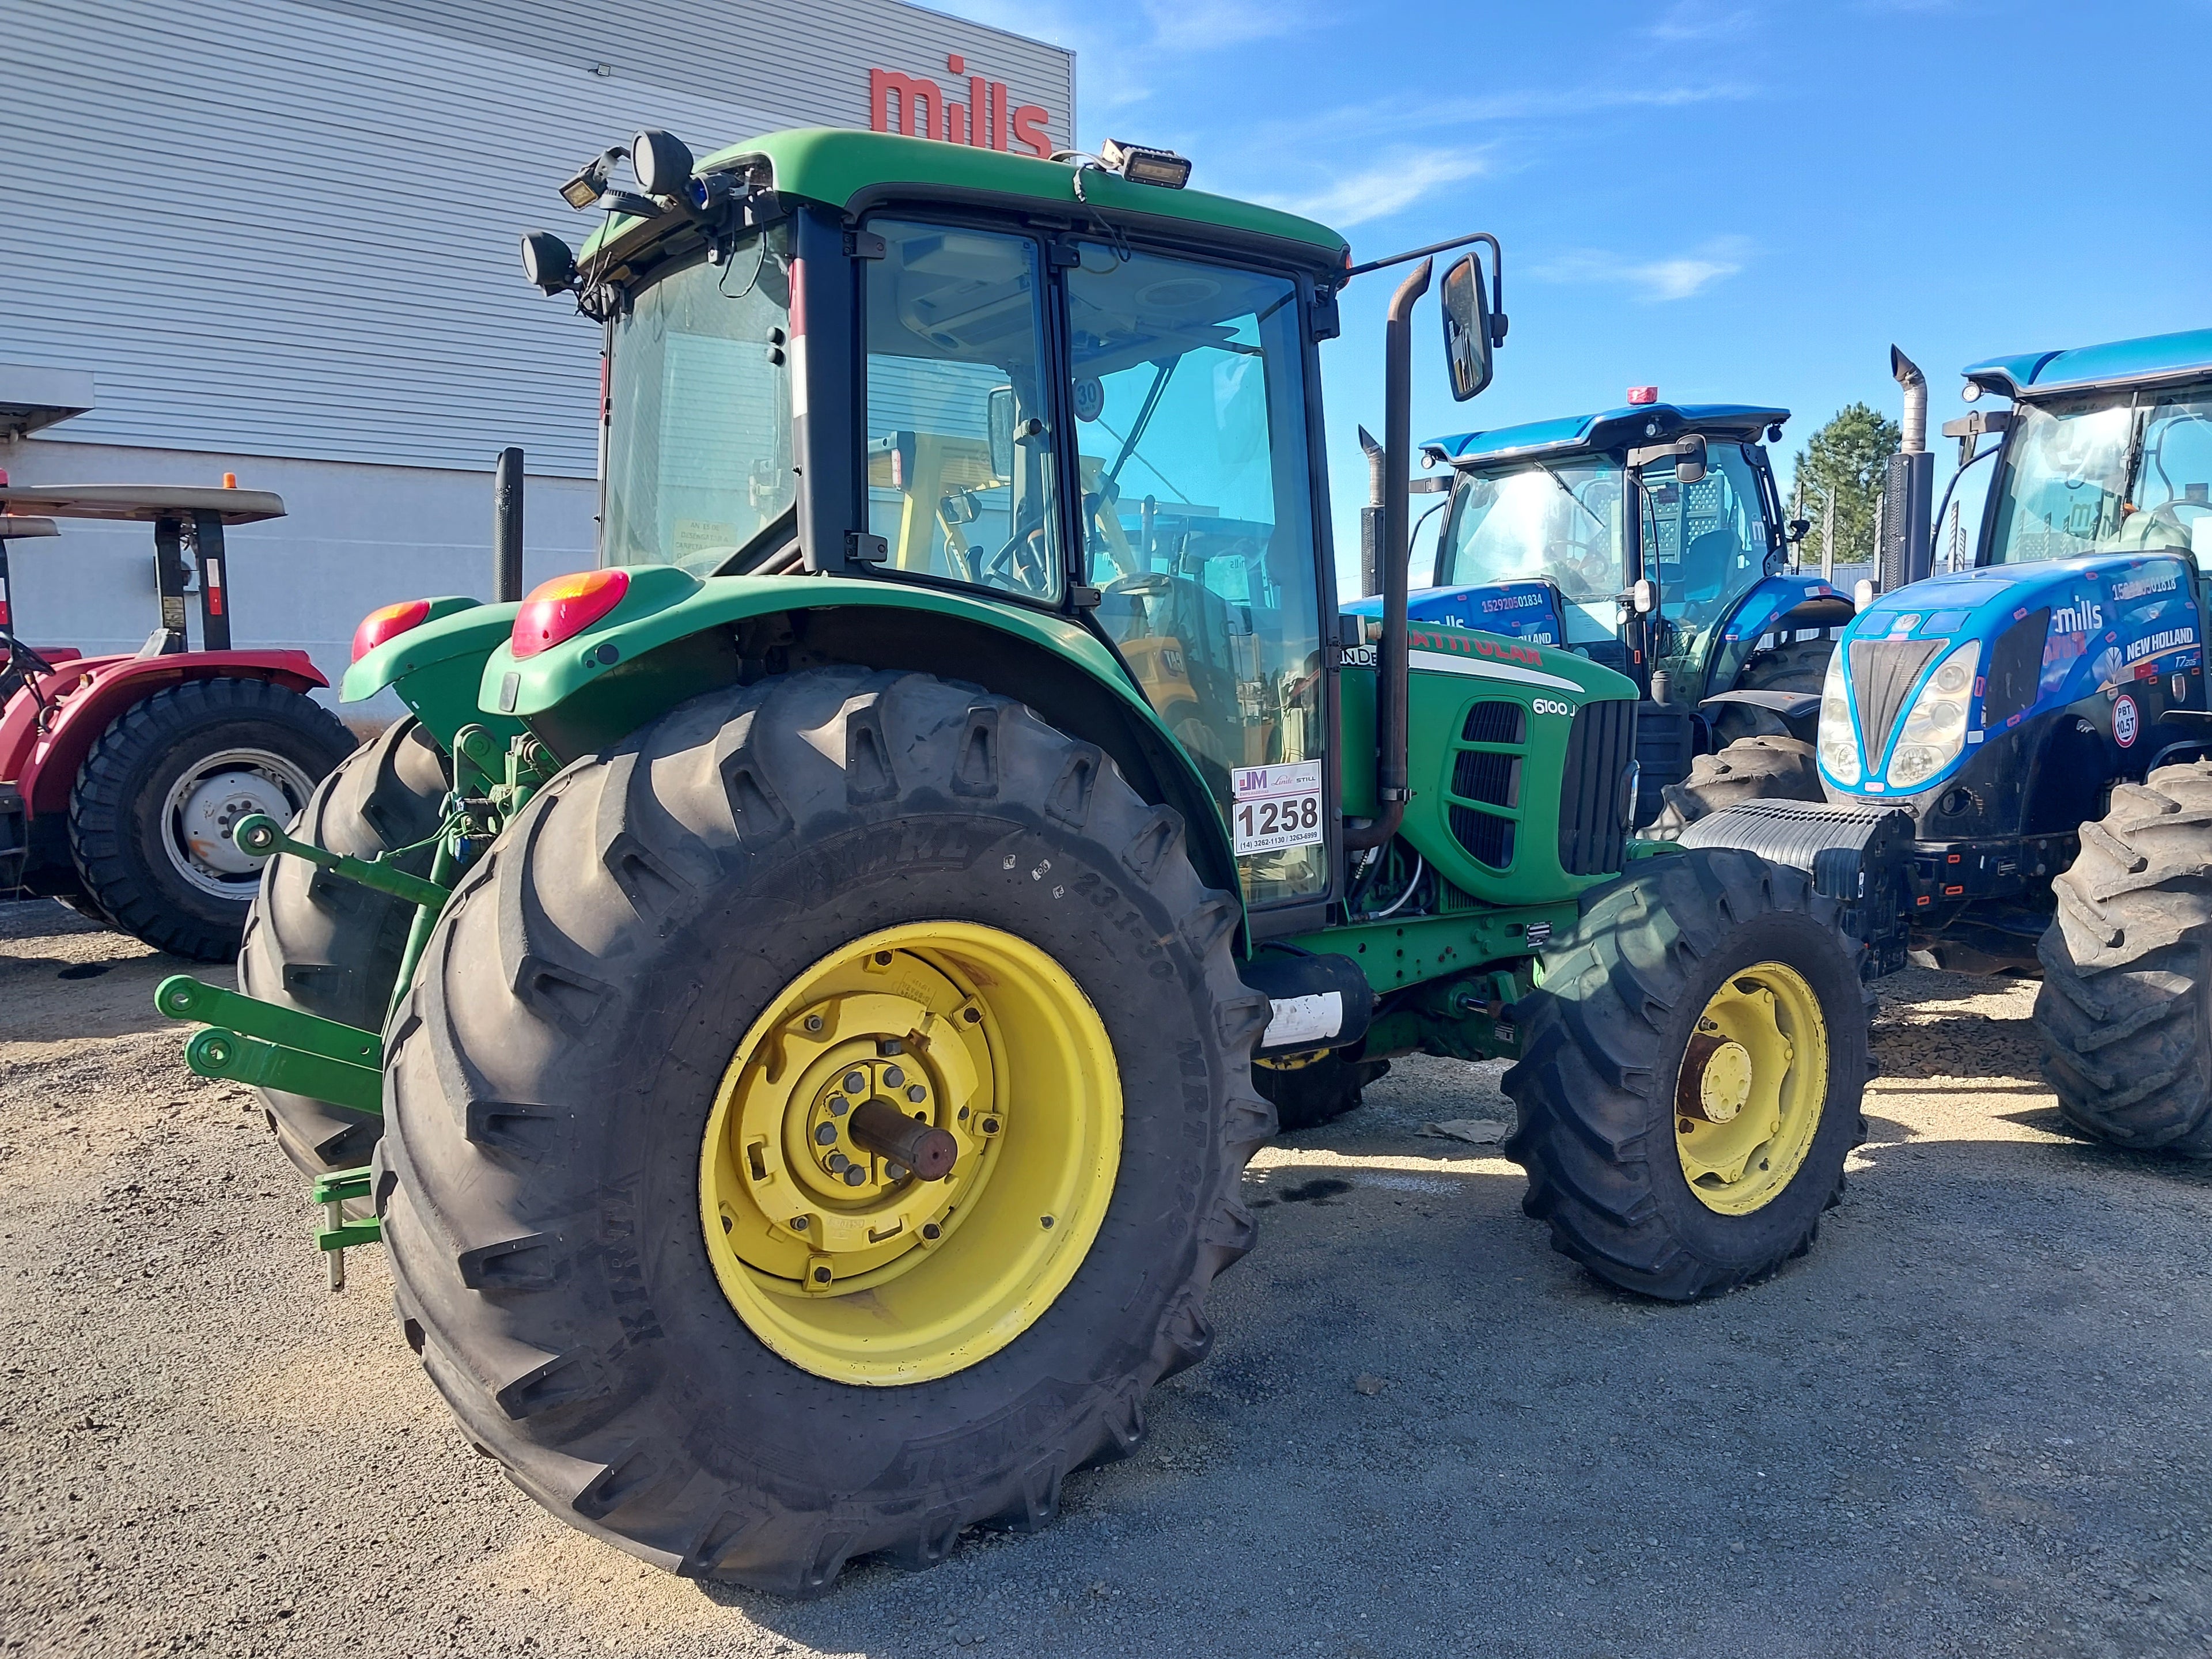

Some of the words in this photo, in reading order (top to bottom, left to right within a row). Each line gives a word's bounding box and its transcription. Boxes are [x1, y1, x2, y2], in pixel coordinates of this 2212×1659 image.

[870, 54, 1052, 160] mills
[1077, 382, 1096, 406] 30
[2055, 595, 2103, 634] mills
[2126, 635, 2150, 662] NEW
[2152, 627, 2193, 652] HOLLAND
[2117, 717, 2134, 734] 10.5T
[2118, 704, 2131, 718] PBT
[1238, 798, 1318, 836] 1258
[1240, 842, 1252, 850] (14)
[1254, 836, 1285, 847] 3262-1130
